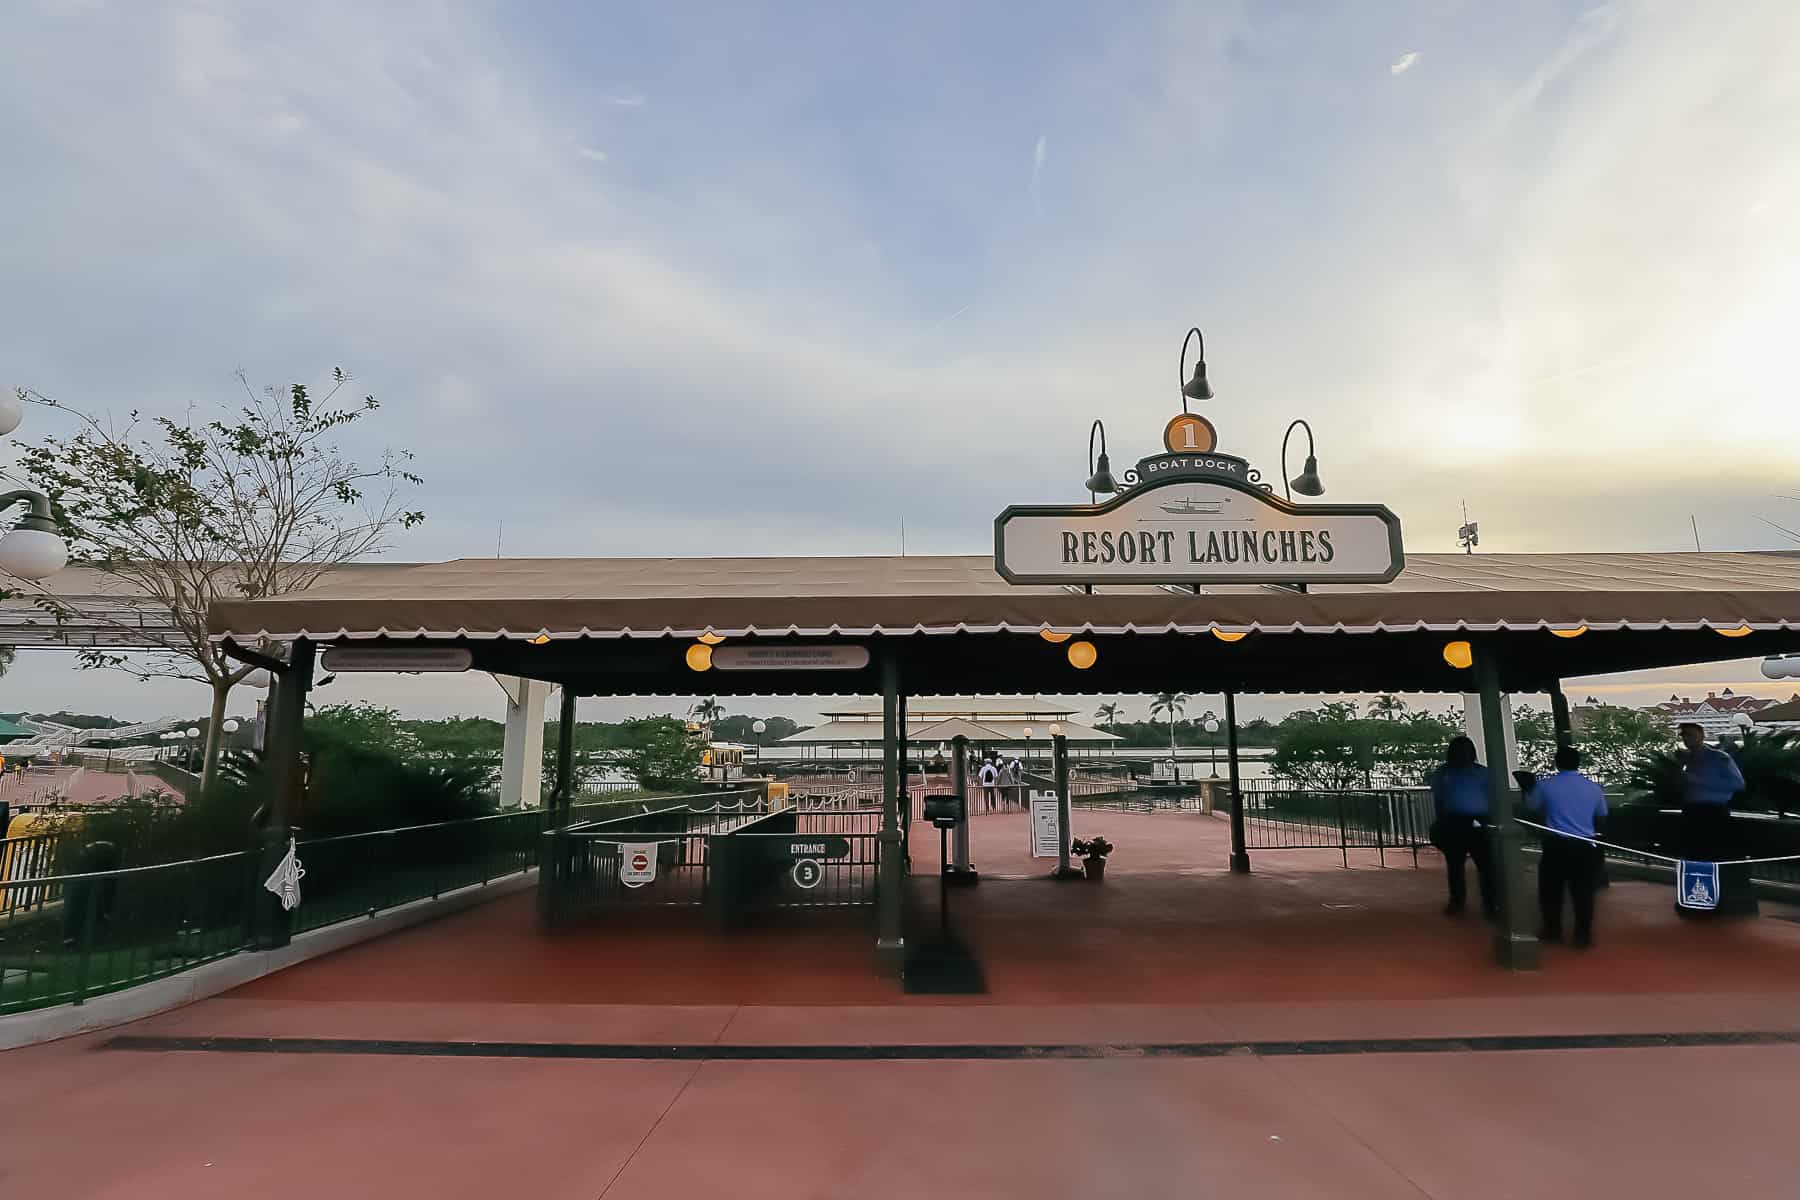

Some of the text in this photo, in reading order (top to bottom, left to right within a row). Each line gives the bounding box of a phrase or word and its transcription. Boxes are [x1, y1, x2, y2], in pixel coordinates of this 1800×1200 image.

[1182, 423, 1199, 448] 1
[1148, 459, 1237, 472] BOAT DOCK
[1061, 529, 1335, 564] RESORT LAUNCHES
[790, 843, 826, 854] ENTRANCE
[803, 866, 813, 880] 3
